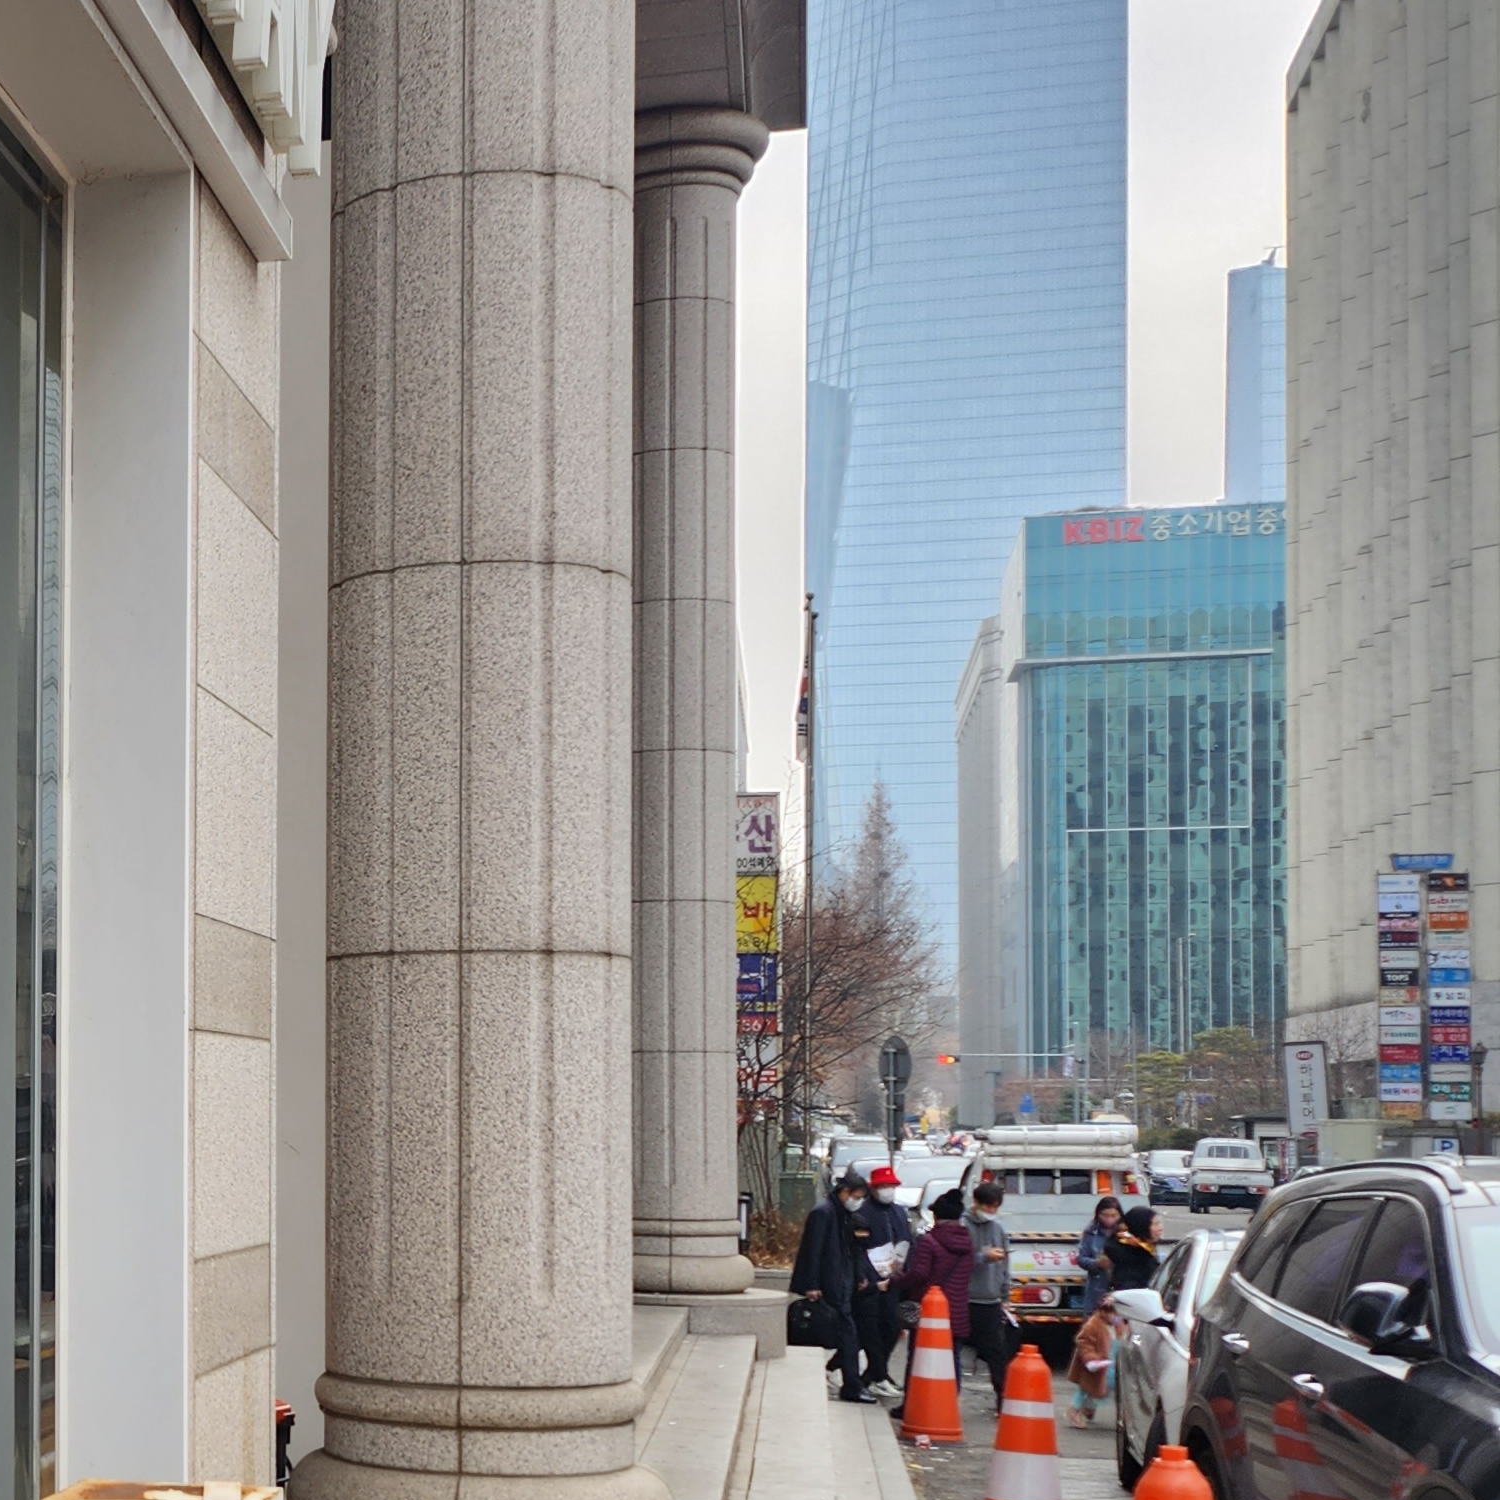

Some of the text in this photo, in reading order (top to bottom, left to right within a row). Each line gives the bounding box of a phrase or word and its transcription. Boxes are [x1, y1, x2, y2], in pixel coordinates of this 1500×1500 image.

[1149, 508, 1287, 542] 중소기업중
[736, 814, 776, 854] 산
[1298, 1062, 1316, 1120] 하나투어
